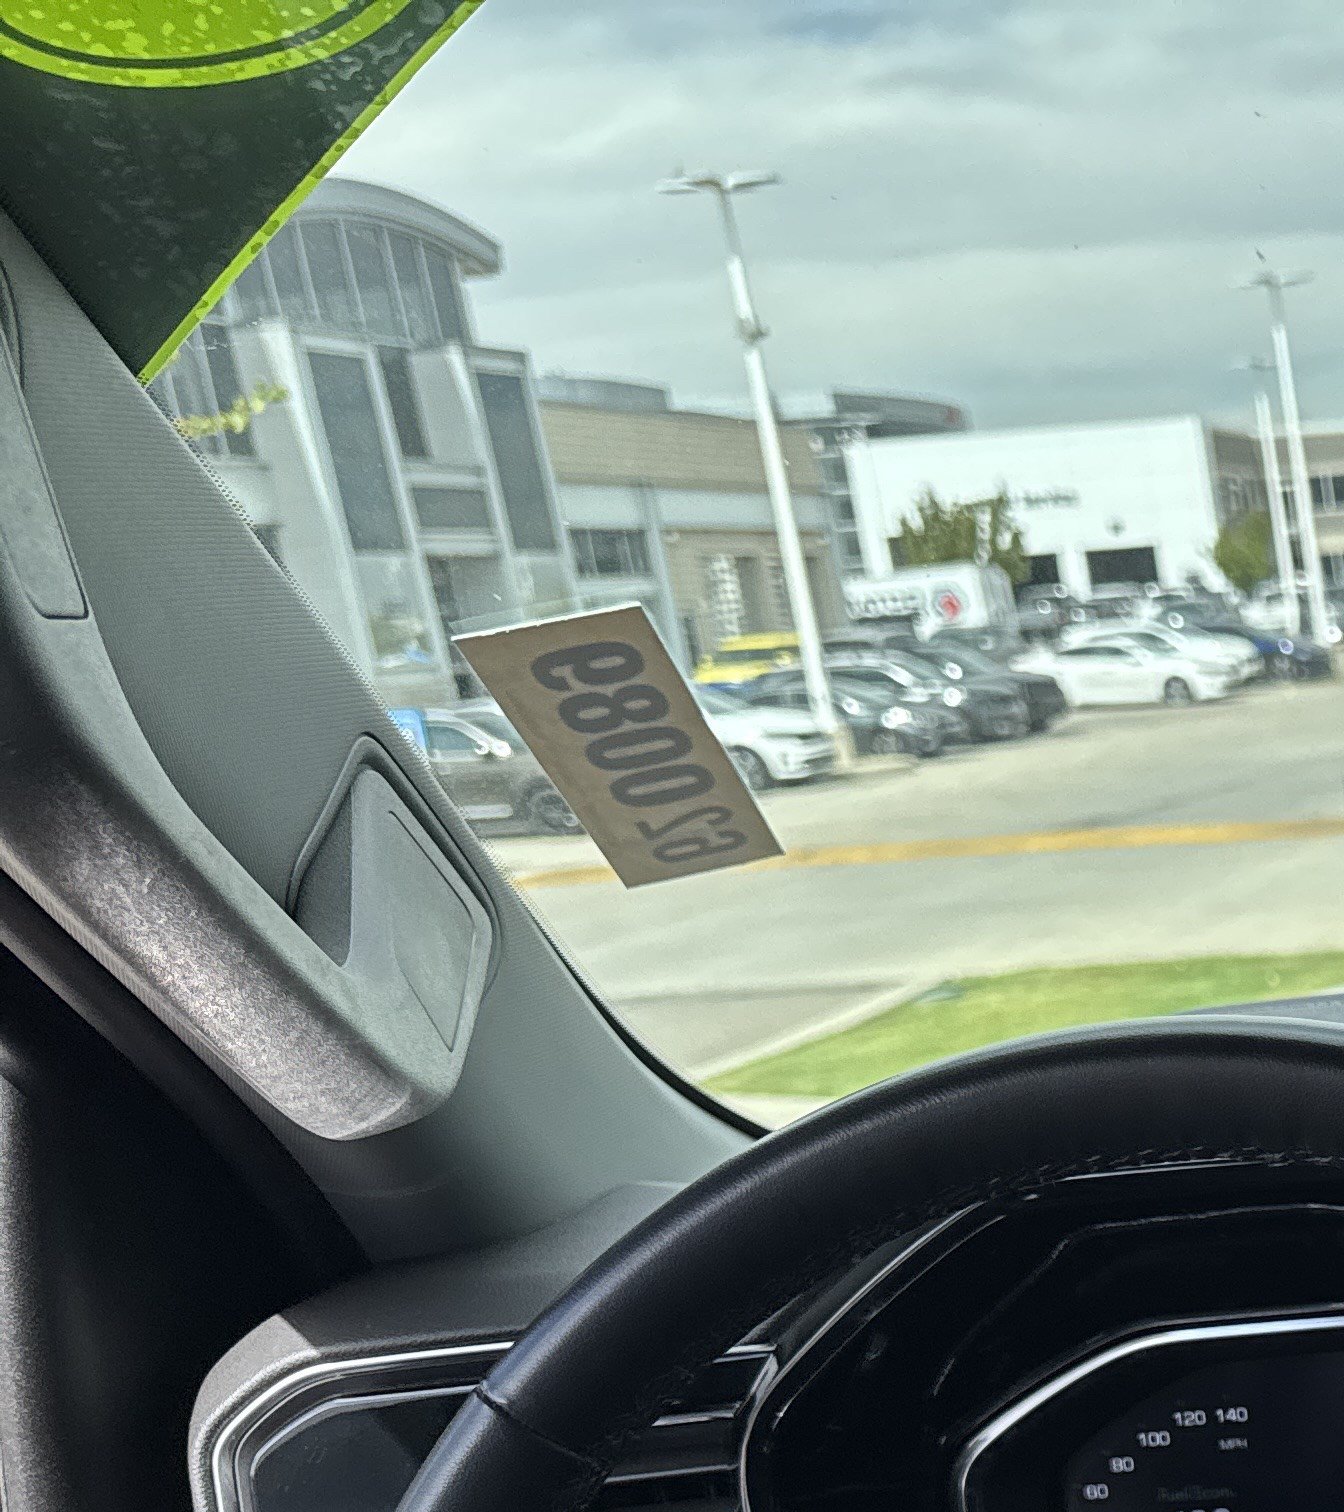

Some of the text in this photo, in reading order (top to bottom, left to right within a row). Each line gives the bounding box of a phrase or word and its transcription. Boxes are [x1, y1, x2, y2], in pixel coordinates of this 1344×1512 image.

[1172, 1410, 1207, 1427] 120
[1215, 1407, 1249, 1424] 140
[1138, 1431, 1171, 1447] 100
[1109, 1456, 1135, 1473] 80
[1083, 1483, 1109, 1500] 60
